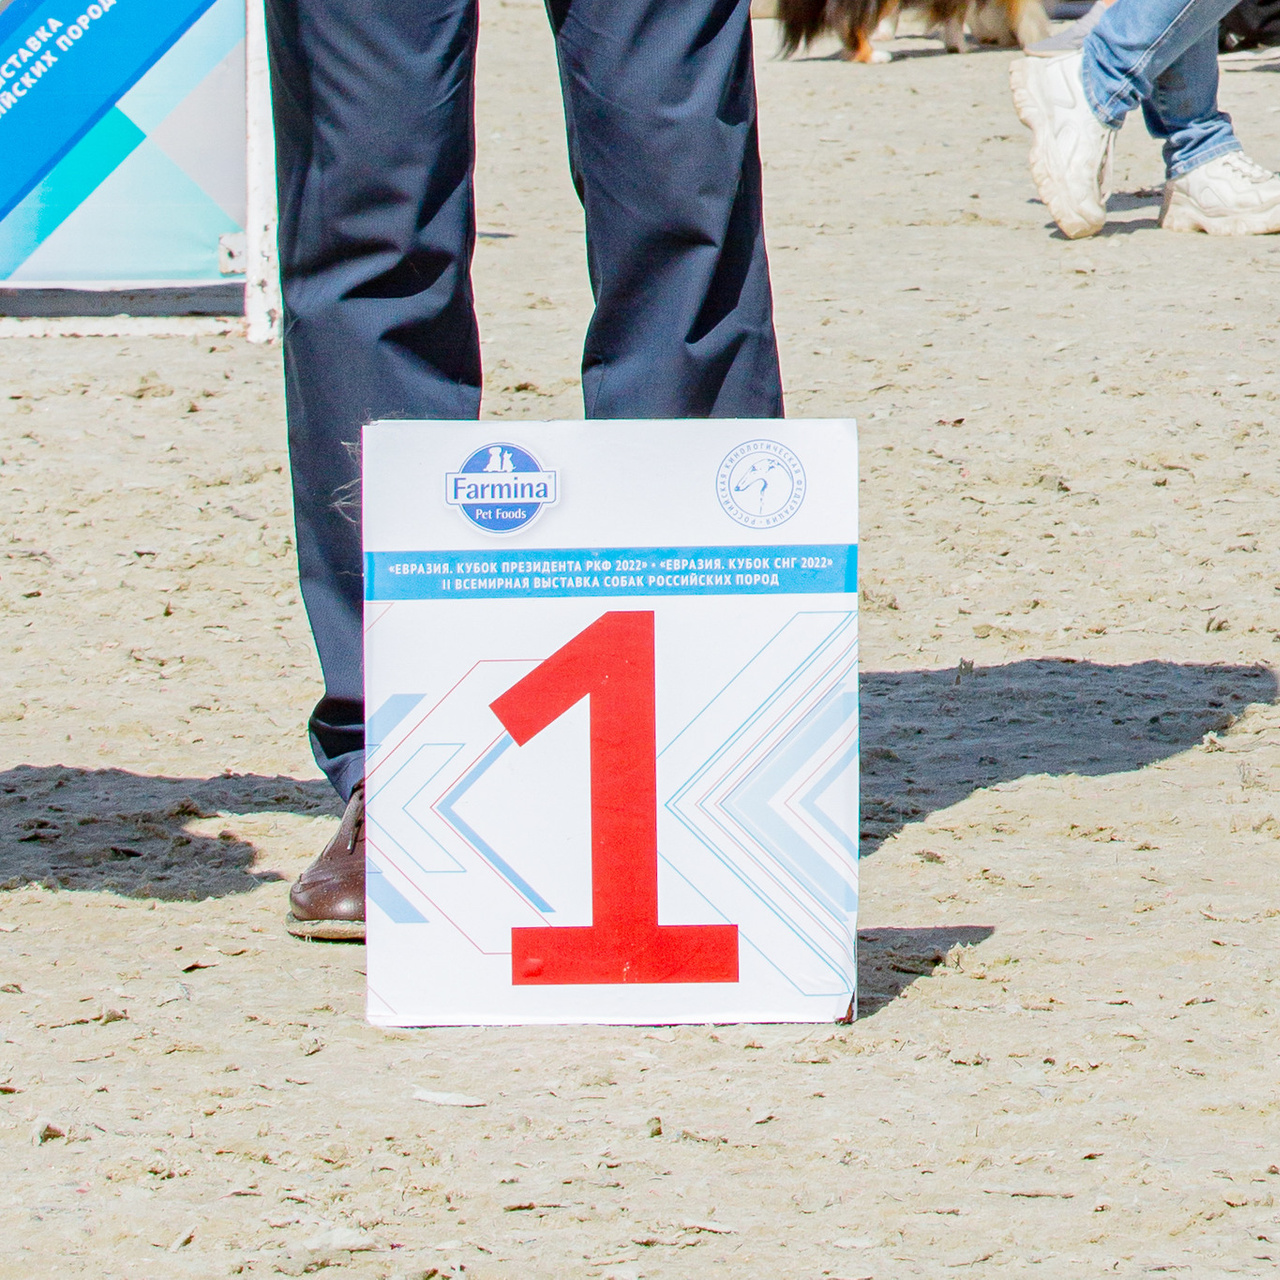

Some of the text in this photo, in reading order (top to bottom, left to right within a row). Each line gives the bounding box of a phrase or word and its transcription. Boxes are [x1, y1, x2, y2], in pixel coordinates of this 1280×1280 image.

[453, 476, 548, 500] Farmina
[475, 508, 527, 520] Pet Foods
[389, 556, 833, 575] «ЕВРАЗИЯ. КУБОК ПРЕЗИДЕНТА РКФ 2022» «ЕВРАЗИЯ. КУБОК СНГ 2022»
[455, 578, 529, 590] ВСЕМИРНАЯ
[534, 576, 600, 588] ВЫСТАВКА
[604, 575, 645, 587] СОБАК
[649, 572, 732, 586] РОССИЙСКИХ
[736, 573, 779, 586] ПОРОД
[489, 610, 739, 985] 1
